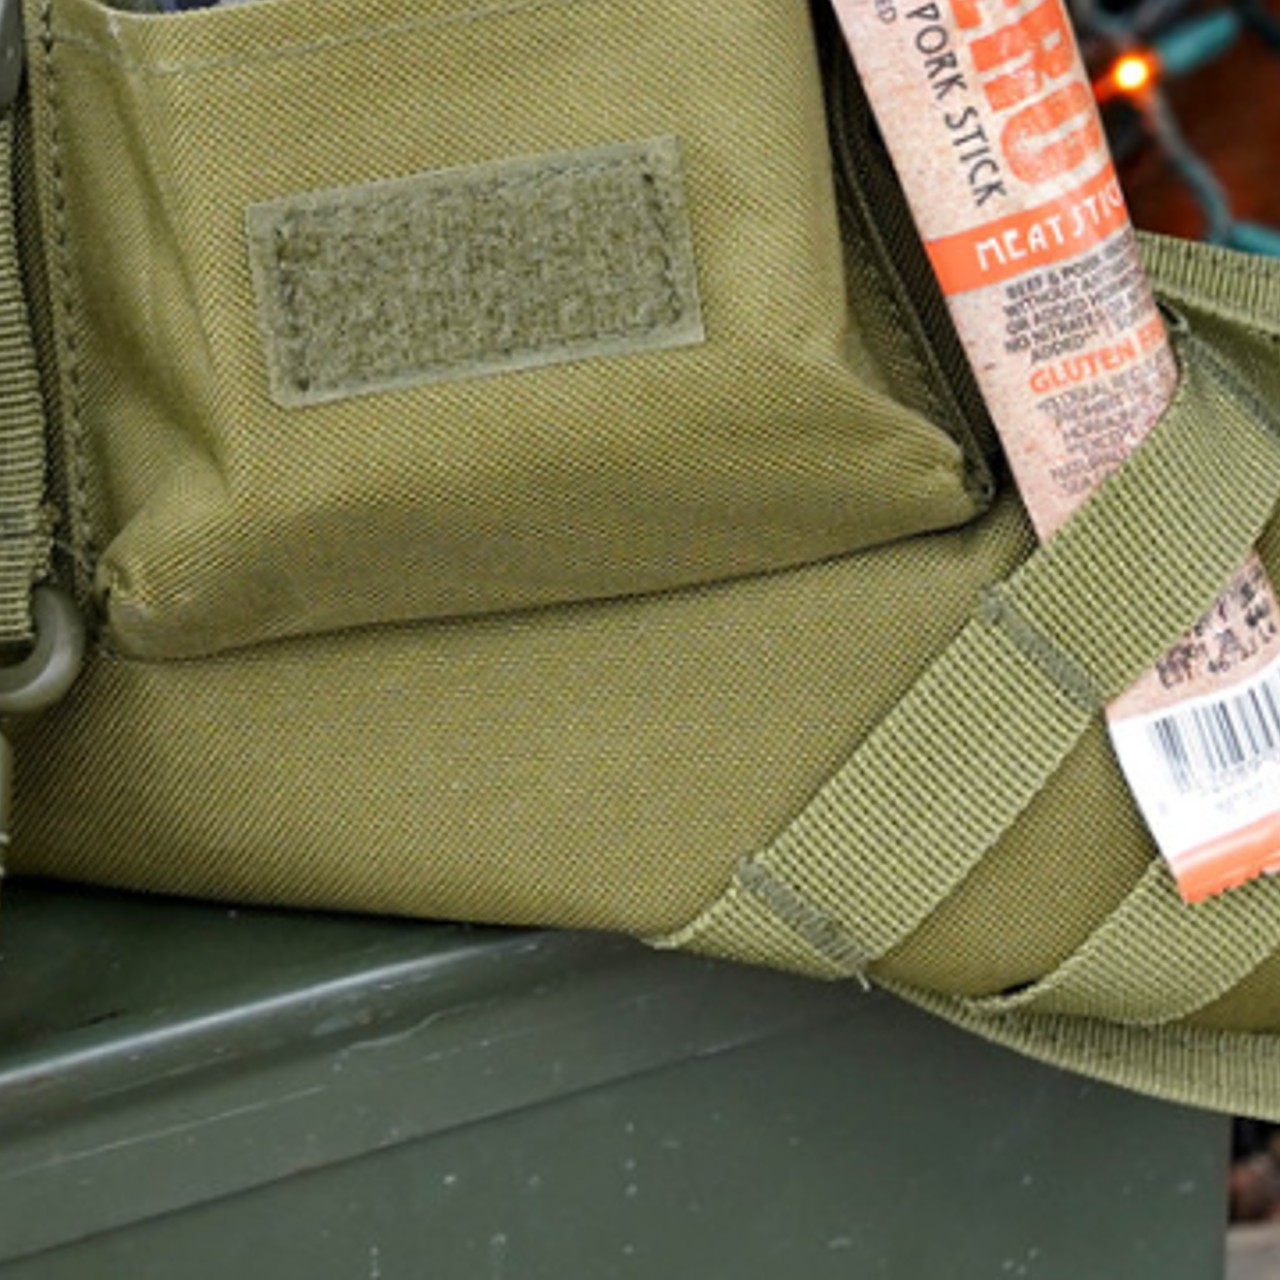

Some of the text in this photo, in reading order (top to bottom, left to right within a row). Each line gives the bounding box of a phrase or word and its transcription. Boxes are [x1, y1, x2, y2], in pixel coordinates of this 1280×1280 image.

[905, 1, 968, 101] PORK
[945, 104, 1007, 209] STICK
[975, 214, 1065, 272] MEAT
[1071, 187, 1123, 238] STIC
[1029, 338, 1137, 394] GLUTEN
